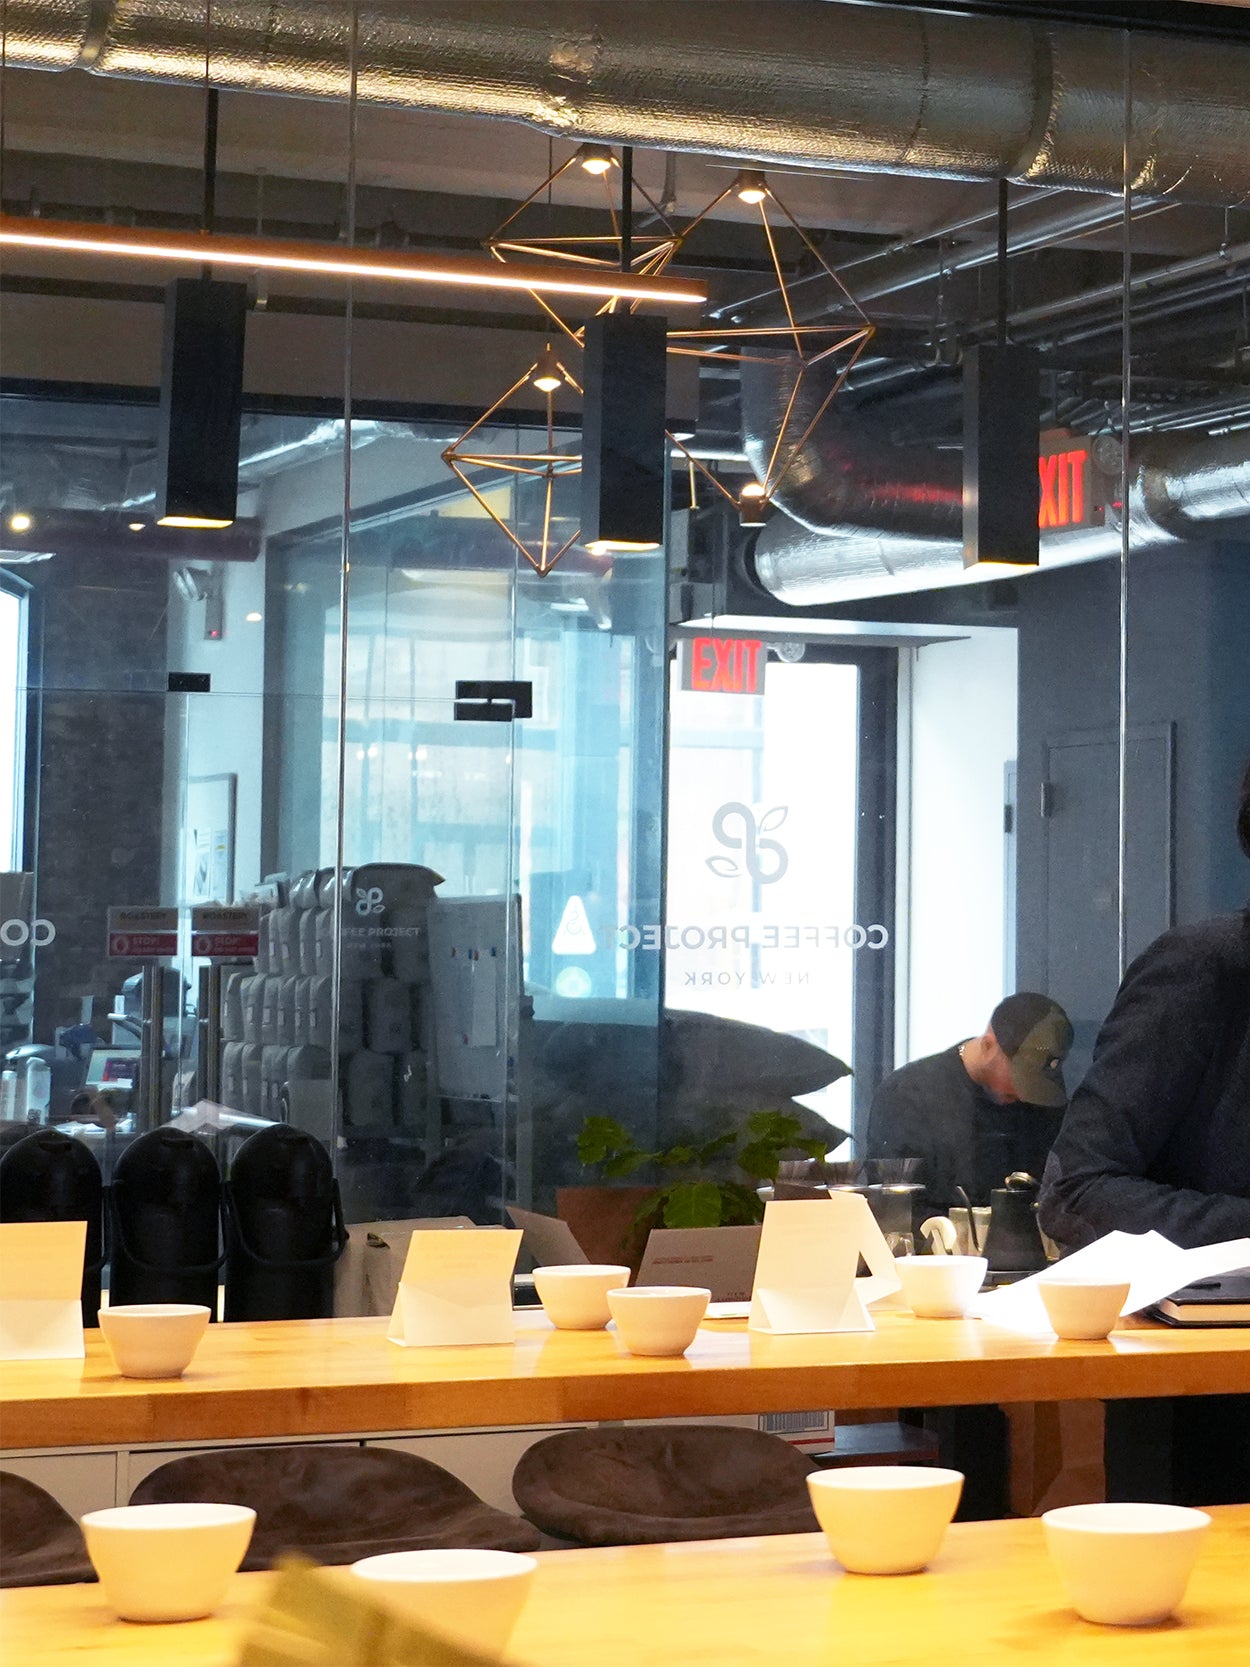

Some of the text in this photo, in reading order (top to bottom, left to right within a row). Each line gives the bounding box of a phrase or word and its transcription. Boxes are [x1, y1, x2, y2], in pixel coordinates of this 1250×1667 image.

[1038, 450, 1087, 529] XIT
[691, 637, 763, 693] EXIT
[368, 927, 420, 937] PROJECT
